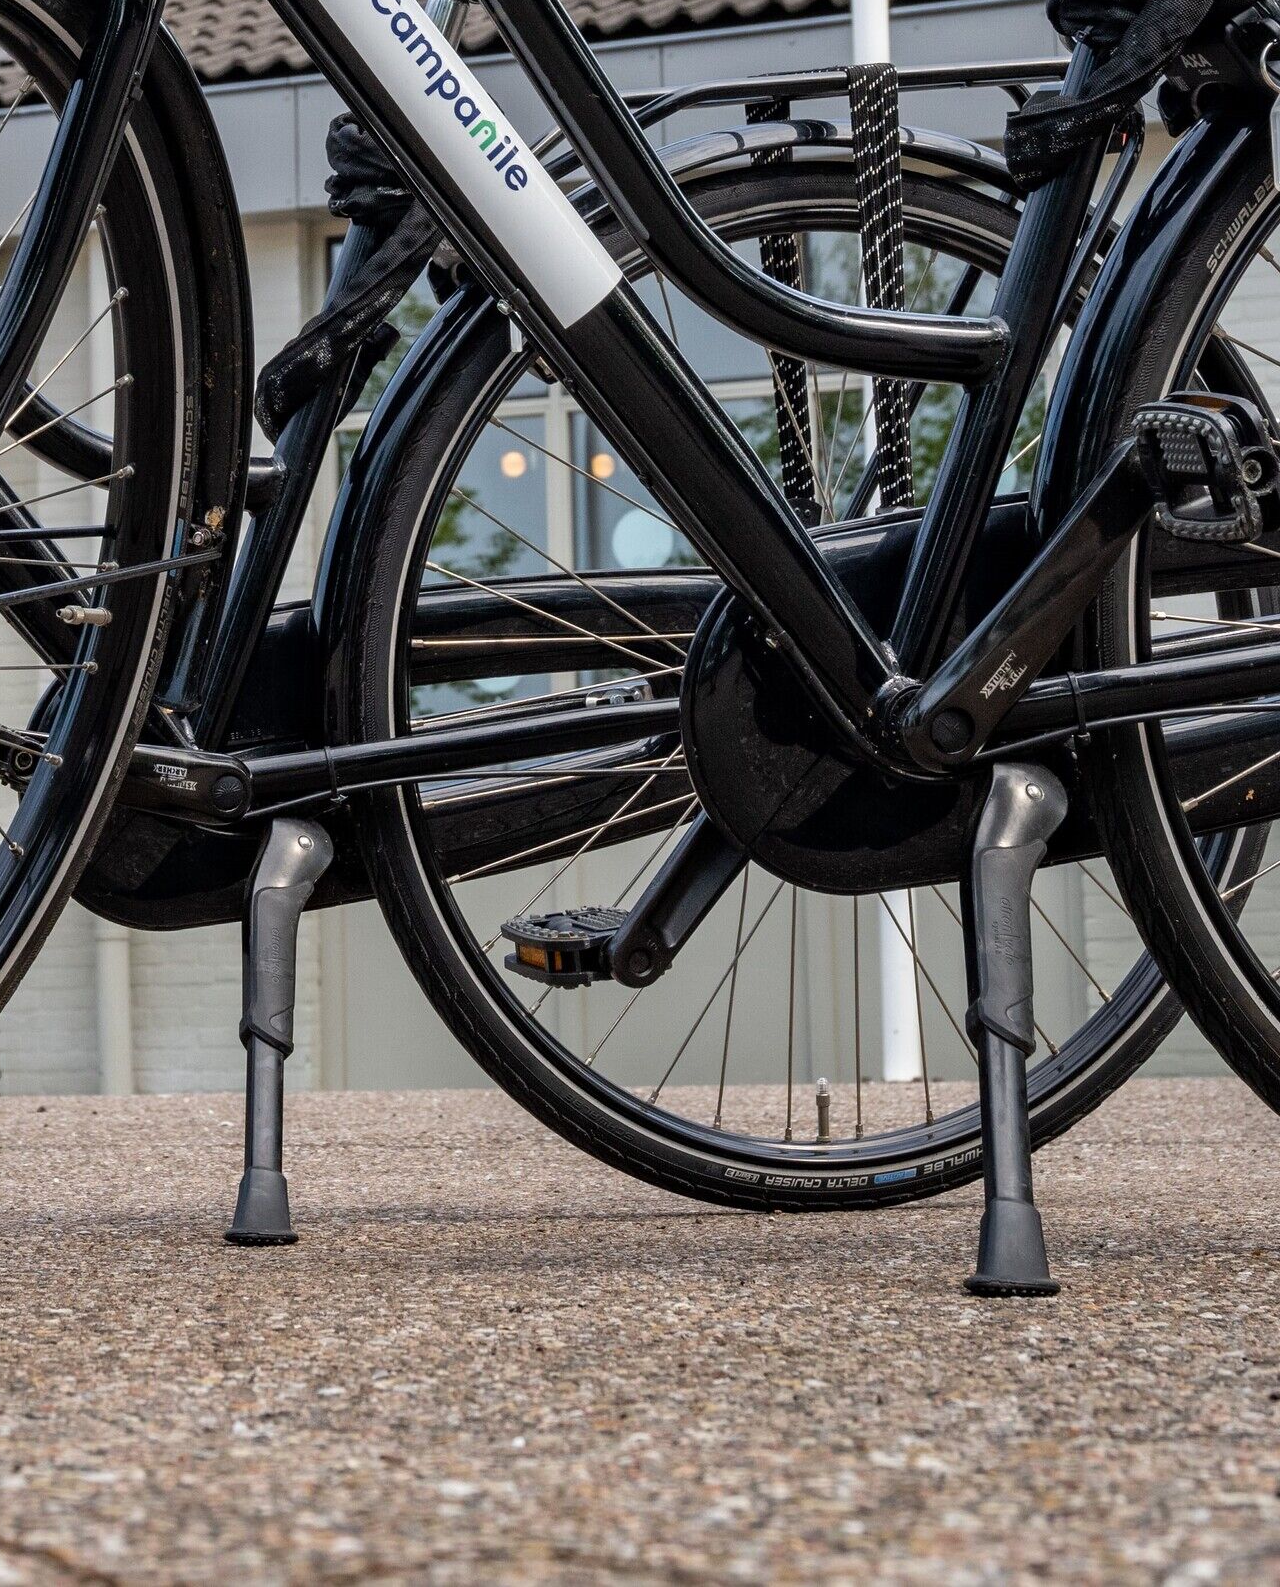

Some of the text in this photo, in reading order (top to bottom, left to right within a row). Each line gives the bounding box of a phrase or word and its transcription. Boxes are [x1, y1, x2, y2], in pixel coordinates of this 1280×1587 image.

[1180, 53, 1213, 69] AXA
[1206, 174, 1278, 274] SCHWALBE
[179, 395, 195, 511] SCHWALBE
[923, 1147, 984, 1174] HWALBE
[765, 1175, 869, 1187] DELTA CRUISER
